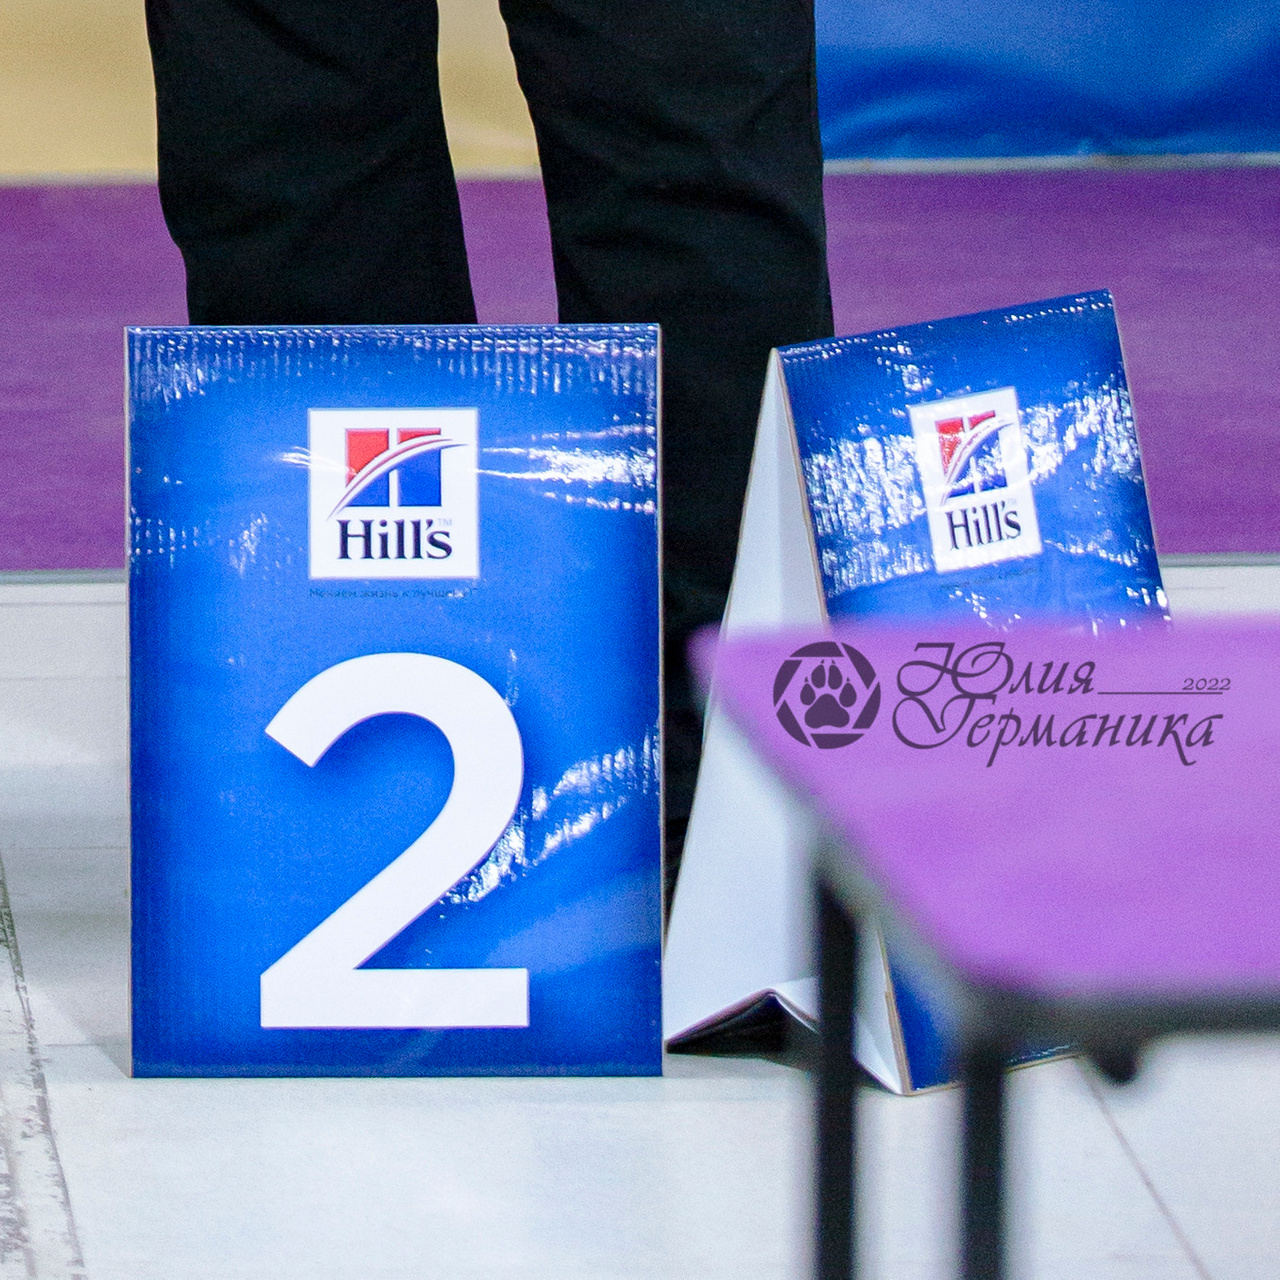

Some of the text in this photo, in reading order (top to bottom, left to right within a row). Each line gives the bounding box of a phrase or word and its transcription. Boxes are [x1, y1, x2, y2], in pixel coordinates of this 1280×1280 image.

[336, 518, 453, 560] Hill's
[945, 500, 1022, 551] Hill's
[260, 652, 530, 1029] 2
